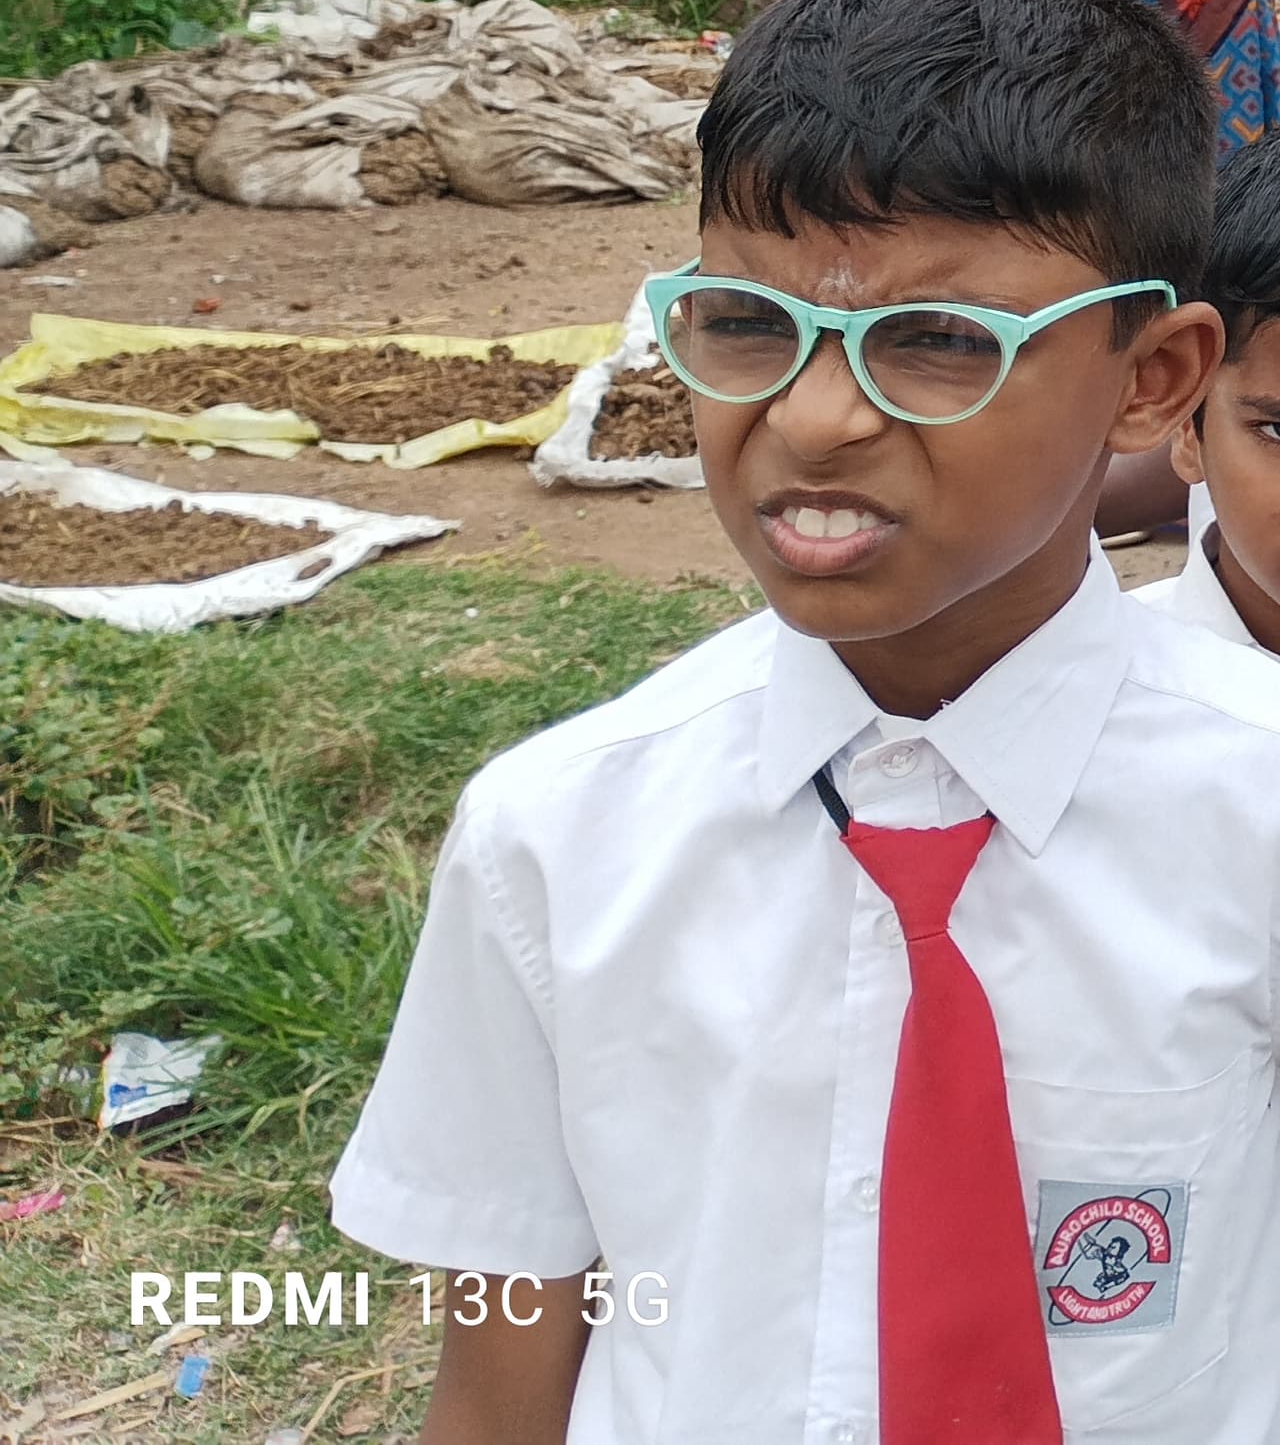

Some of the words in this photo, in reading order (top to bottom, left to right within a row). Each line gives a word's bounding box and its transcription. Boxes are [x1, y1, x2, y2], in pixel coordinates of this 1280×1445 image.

[1050, 1201, 1123, 1266] AUROCHILD
[1124, 1204, 1166, 1256] SCHOOL
[1059, 1289, 1088, 1318] LIGHT
[1109, 1286, 1145, 1316] TRUTH
